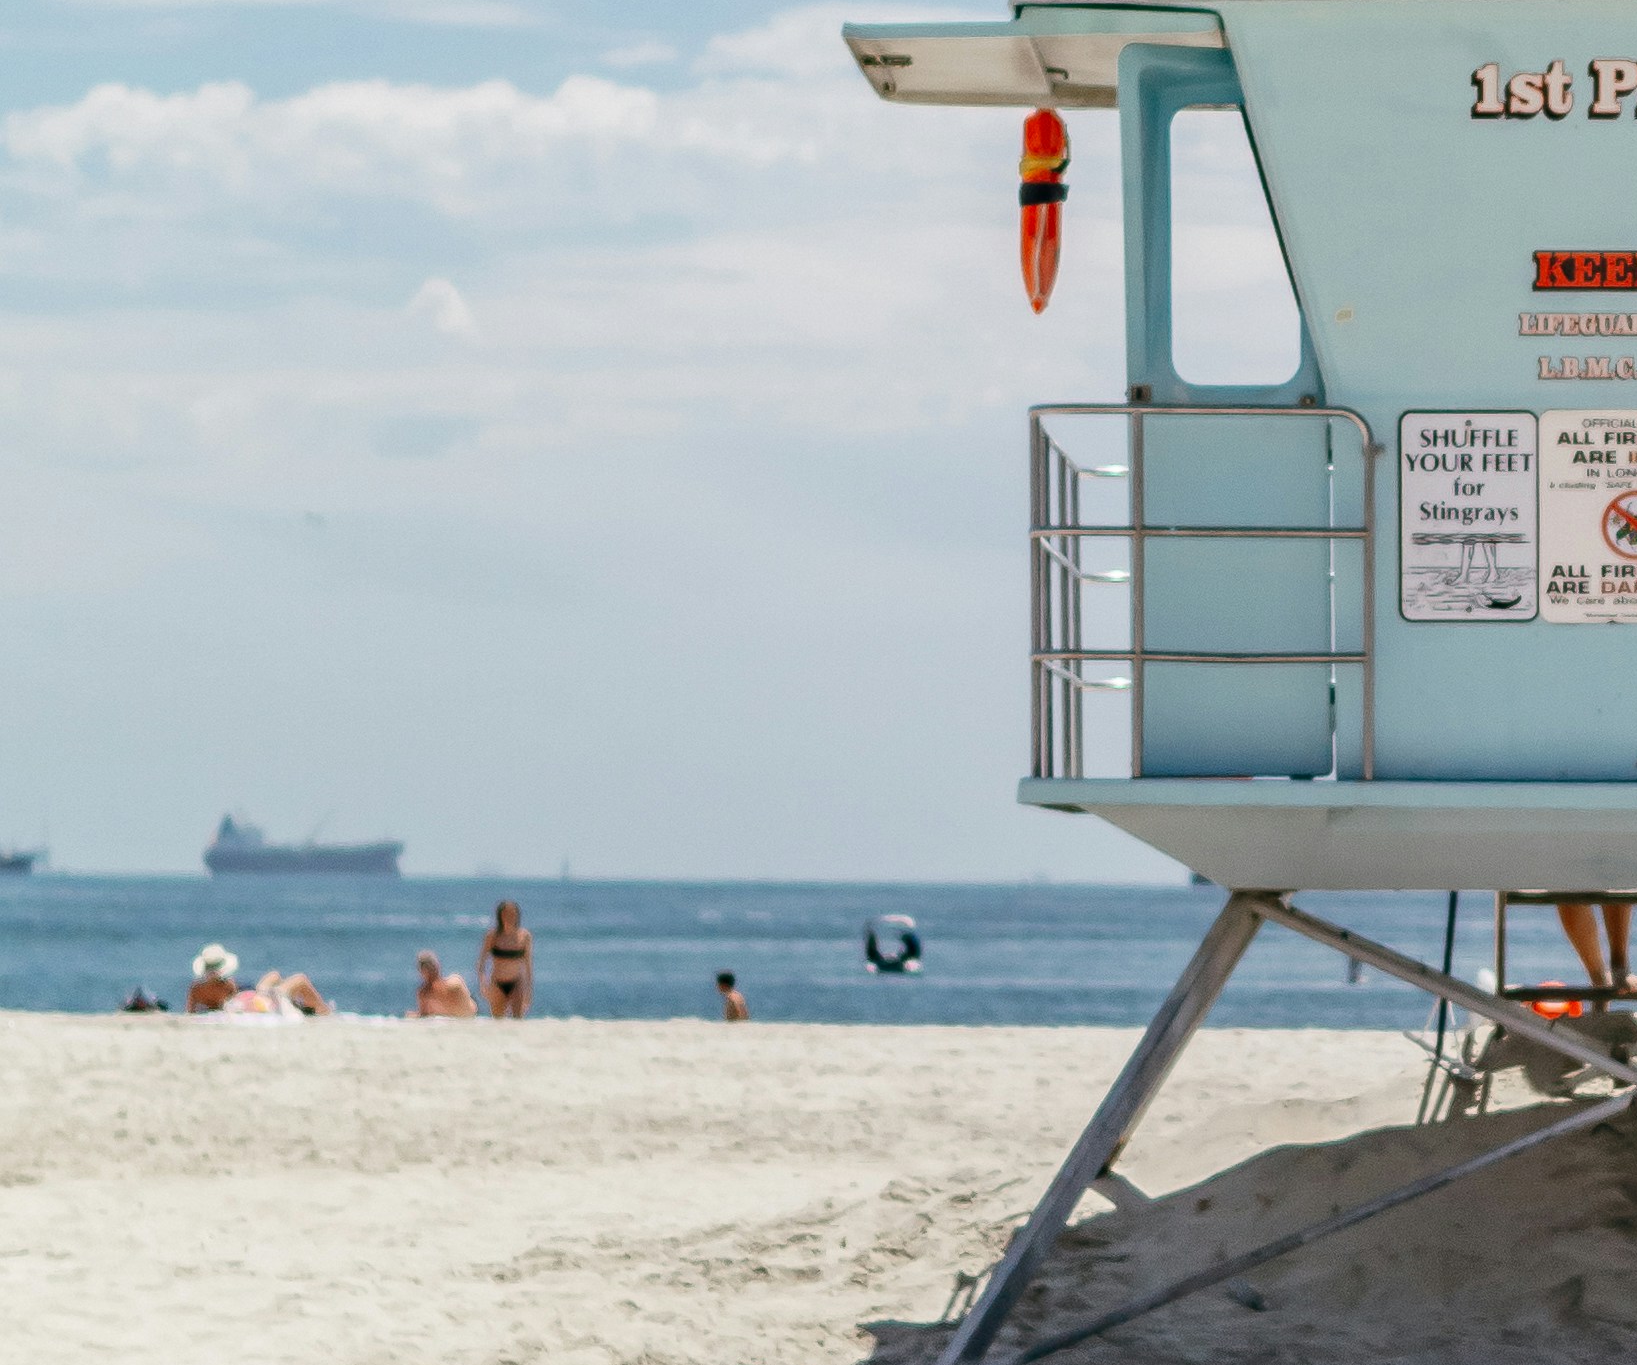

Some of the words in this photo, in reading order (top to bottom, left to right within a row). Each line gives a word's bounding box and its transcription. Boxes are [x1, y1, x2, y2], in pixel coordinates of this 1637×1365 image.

[1471, 60, 1574, 120] 1st
[1582, 419, 1637, 429] OFFICIAL
[1420, 429, 1518, 448] SHUFFLE
[1557, 431, 1595, 445] ALL
[1405, 453, 1473, 472] YOUR
[1482, 453, 1534, 472] FEET
[1572, 450, 1617, 464] ARE
[1586, 468, 1600, 478] IN
[1453, 476, 1485, 496] for
[1420, 500, 1519, 526] Stingrays
[1551, 565, 1592, 578] ALL
[1546, 581, 1590, 594] ARE
